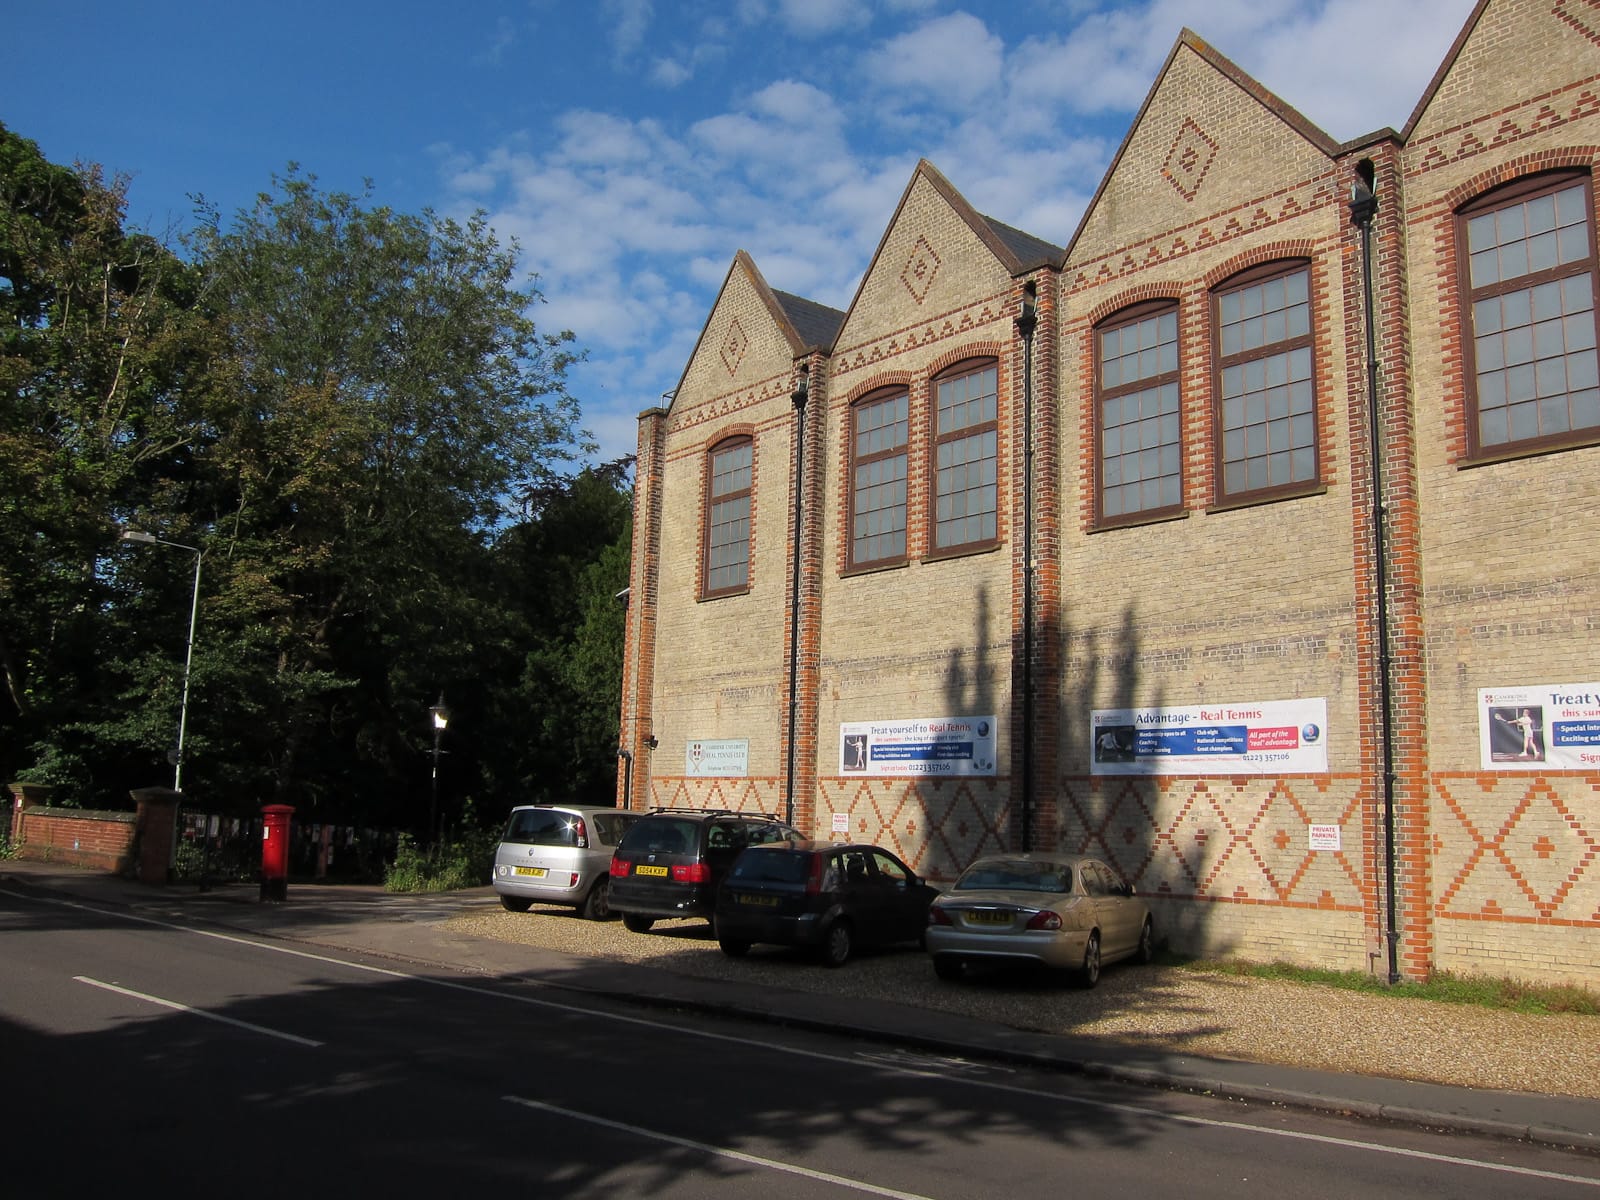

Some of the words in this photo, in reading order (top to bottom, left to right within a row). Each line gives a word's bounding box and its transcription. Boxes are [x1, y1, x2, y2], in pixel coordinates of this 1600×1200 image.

[1550, 693, 1592, 705] Treat
[1136, 712, 1190, 725] Advantage
[1200, 709, 1224, 720] Real
[1226, 708, 1262, 720] Tennis
[1562, 708, 1580, 717] this
[870, 726, 888, 734] Treat
[889, 724, 919, 736] yourself
[920, 725, 928, 733] to
[929, 723, 945, 732] Real
[946, 722, 971, 732] Tennis
[1258, 732, 1272, 740] part
[1273, 730, 1278, 738] of
[1265, 752, 1290, 762] 357106
